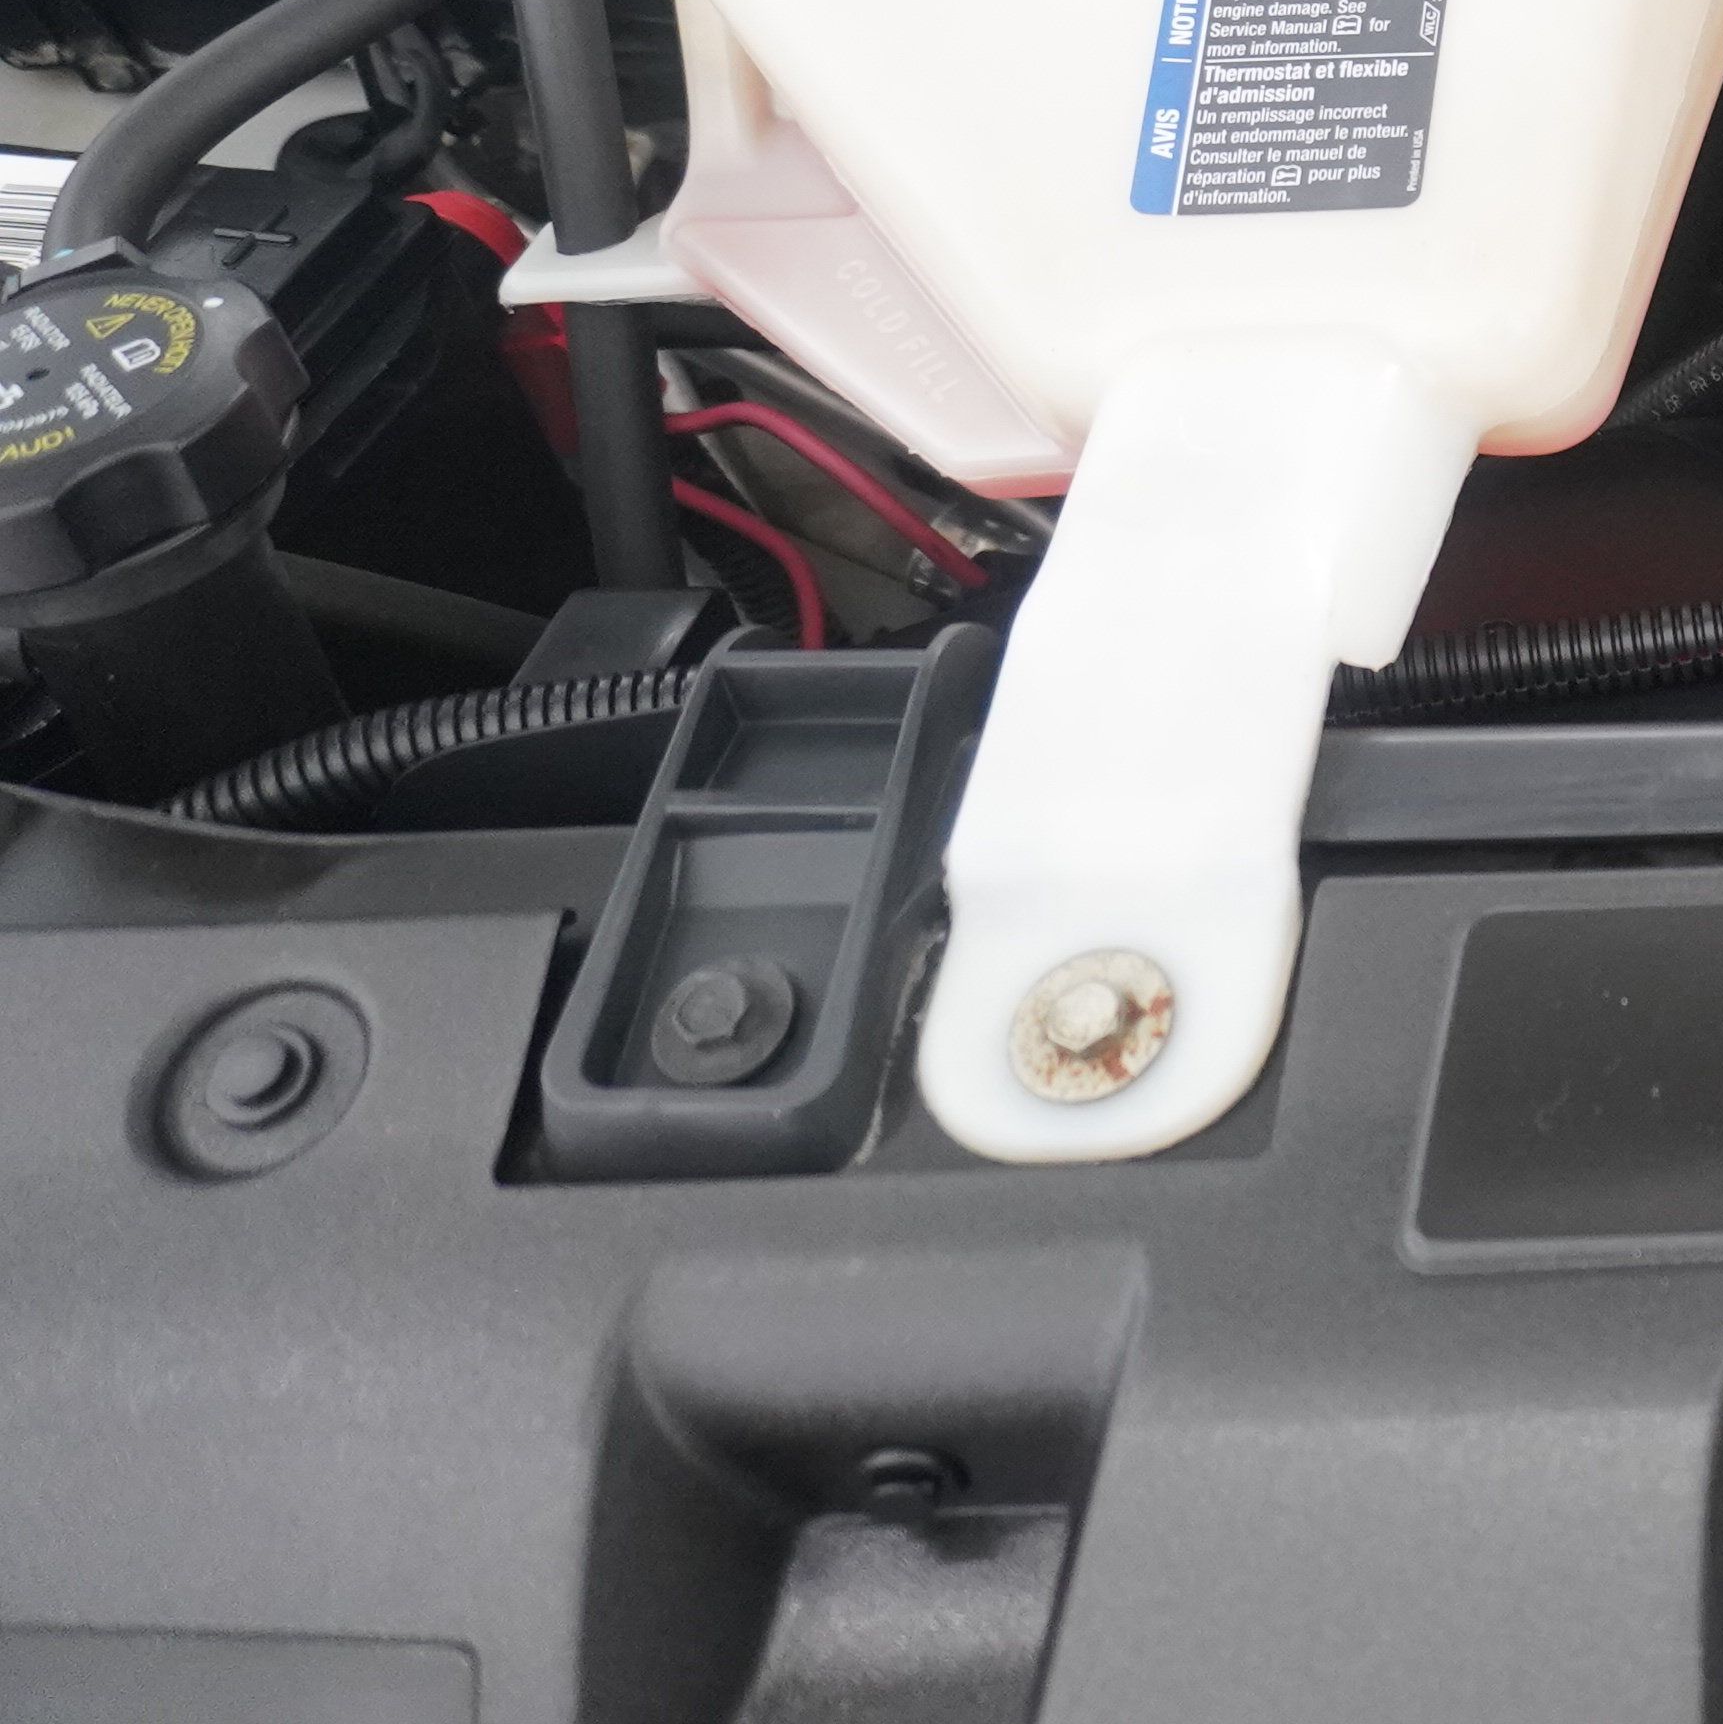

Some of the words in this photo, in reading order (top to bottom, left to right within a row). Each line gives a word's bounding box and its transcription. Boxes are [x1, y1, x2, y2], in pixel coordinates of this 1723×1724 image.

[1213, 3, 1265, 19] engine
[1269, 0, 1332, 18] damage.
[1337, 0, 1367, 13] See
[1210, 21, 1267, 38] Service
[1271, 19, 1327, 36] Manual
[1369, 17, 1391, 31] for
[1424, 9, 1439, 36] WLC
[1207, 42, 1246, 57] more
[1250, 39, 1342, 56] information.
[1204, 63, 1311, 84] Thermostat
[1315, 63, 1334, 79] et
[1339, 60, 1409, 79] flexible
[1200, 85, 1315, 104] d'admission
[1196, 108, 1217, 125] Un
[1221, 105, 1314, 125] remplissage
[1319, 104, 1388, 121] incorrect
[1150, 109, 1181, 160] AVIS
[1193, 129, 1230, 147] peut
[1234, 126, 1332, 146] endommager
[1335, 125, 1349, 140] le
[1353, 124, 1408, 140] moteur.
[1413, 129, 1424, 148] USA
[1190, 148, 1264, 166] Consulter
[1268, 147, 1281, 162] le
[1287, 145, 1343, 161] manuel
[1347, 145, 1366, 160] de
[1186, 168, 1266, 188] réparation
[1308, 166, 1342, 185] pour
[1348, 164, 1381, 182] plus
[1183, 188, 1291, 205] d'information.
